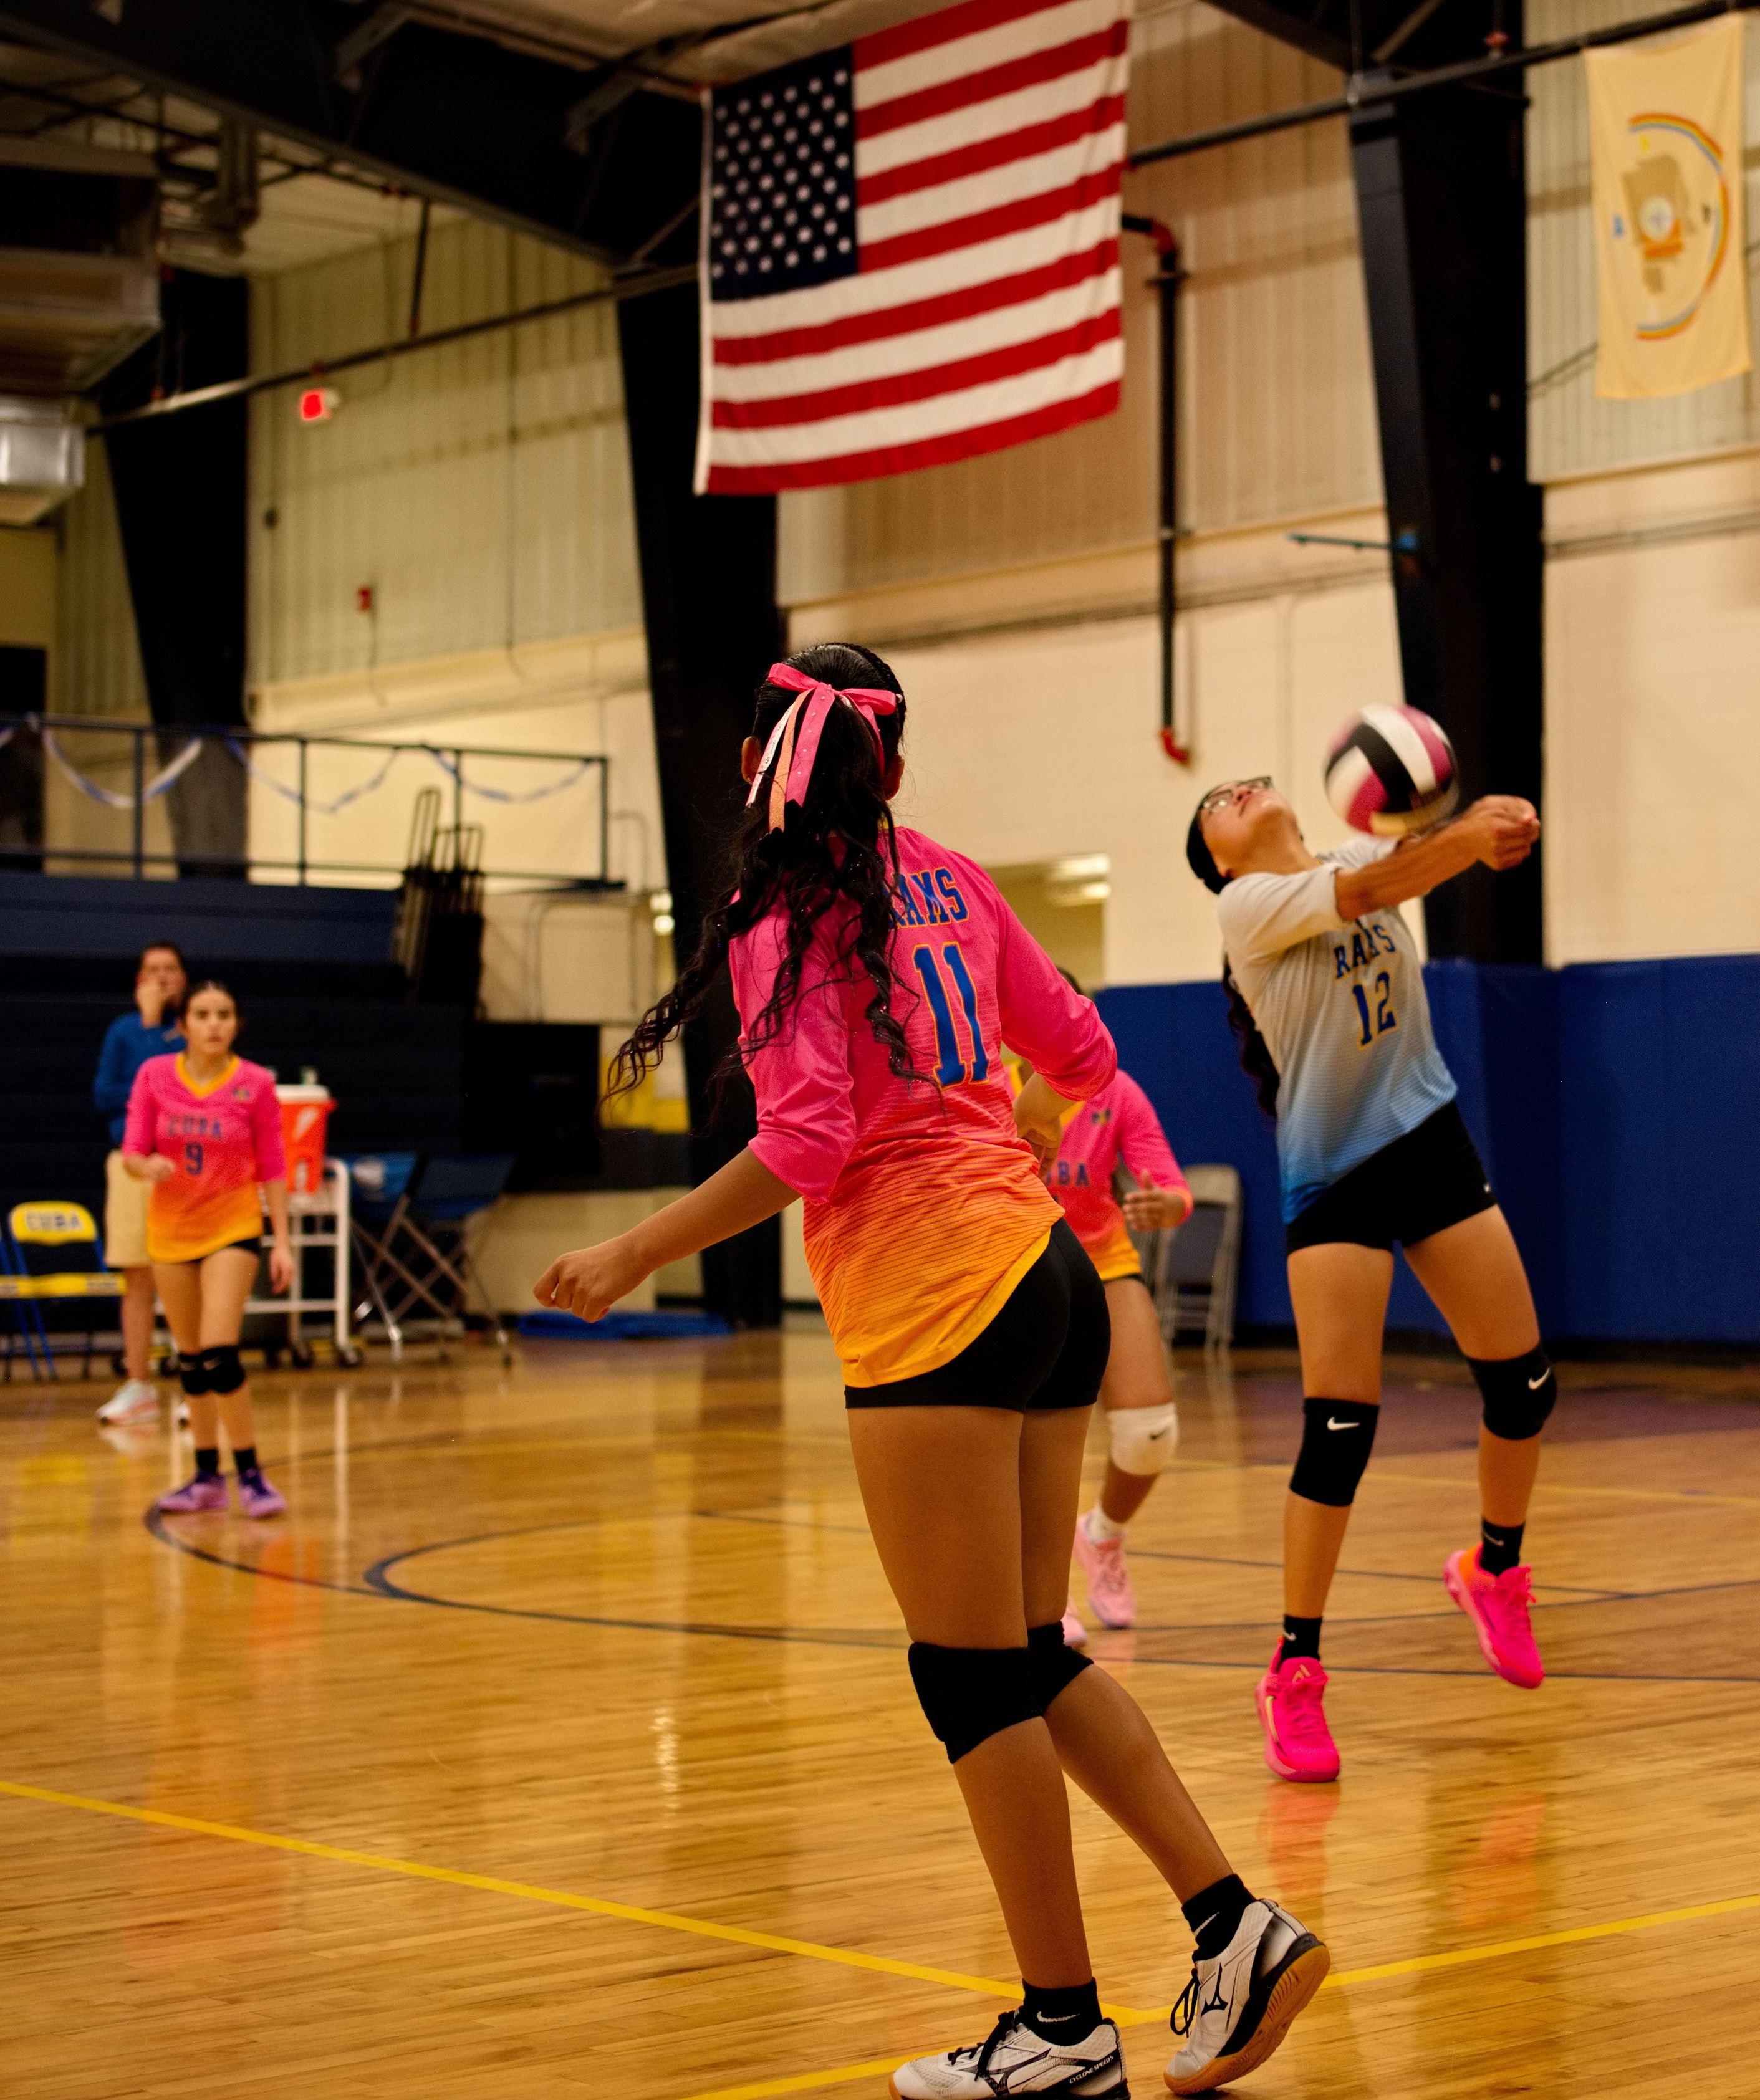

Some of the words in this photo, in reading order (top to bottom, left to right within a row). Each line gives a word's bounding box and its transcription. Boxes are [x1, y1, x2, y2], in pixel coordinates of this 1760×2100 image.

[912, 941, 989, 1091] 11
[1352, 968, 1400, 1050] 12
[185, 1141, 204, 1177] 9
[1069, 2066, 1094, 2084] CYCLONE
[1094, 2057, 1111, 2071] SPEED
